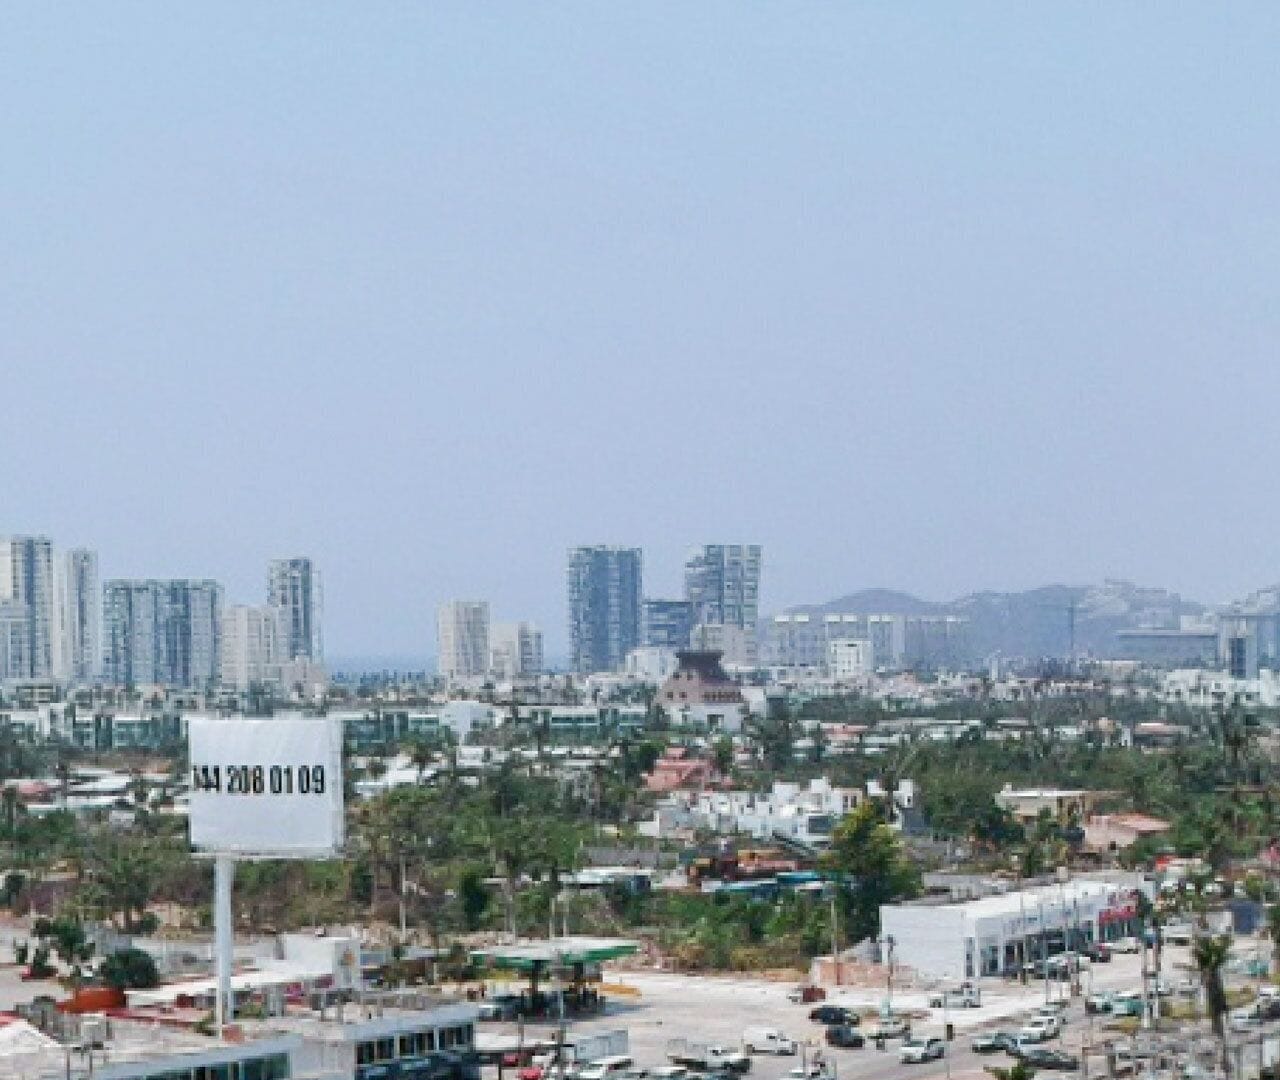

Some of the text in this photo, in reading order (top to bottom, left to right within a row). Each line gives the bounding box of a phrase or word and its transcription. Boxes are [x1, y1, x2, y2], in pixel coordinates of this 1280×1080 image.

[227, 764, 264, 794] 208
[269, 764, 293, 794] 01
[298, 764, 325, 794] 09
